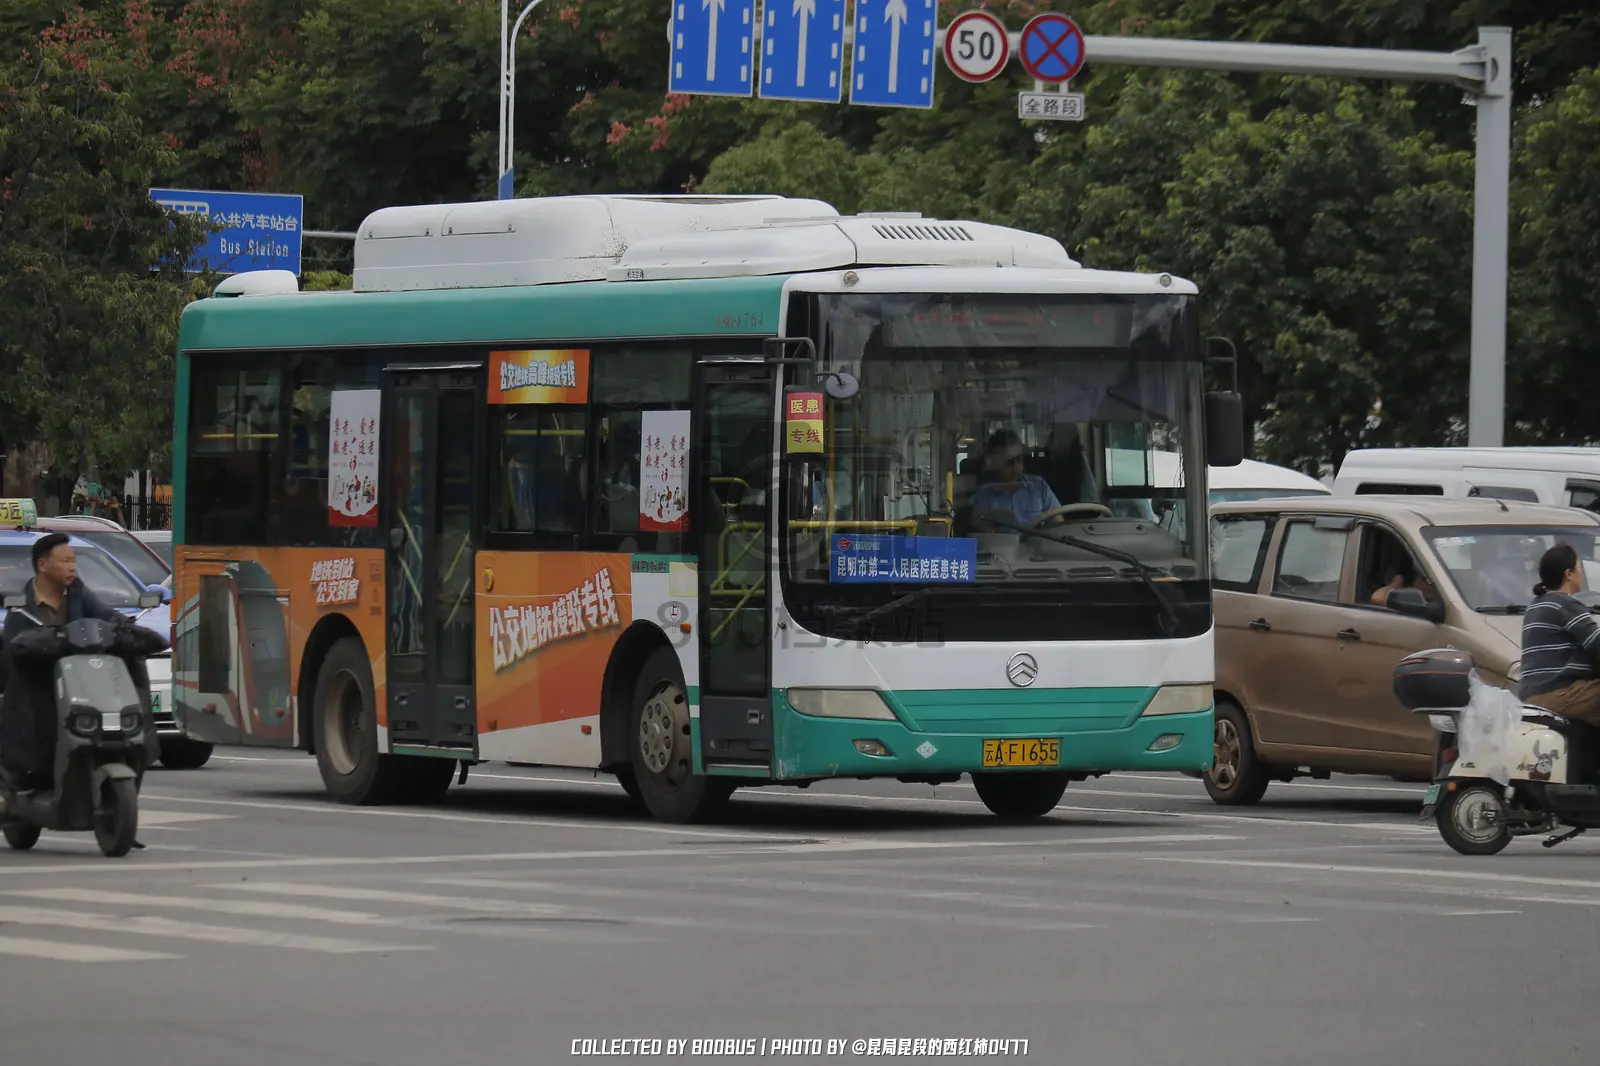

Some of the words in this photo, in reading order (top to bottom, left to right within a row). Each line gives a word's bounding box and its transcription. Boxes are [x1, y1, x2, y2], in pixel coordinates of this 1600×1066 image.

[958, 30, 995, 60] 50
[1025, 98, 1078, 115] 全路段
[213, 211, 298, 231] 公共汽车站台
[220, 238, 241, 255] Bus
[247, 239, 289, 257] Station
[790, 399, 820, 414] 医患
[790, 428, 820, 444] 专线
[310, 558, 354, 582] 地铁到站
[837, 555, 969, 581] 昆明市第二人民医院医患专线
[316, 579, 360, 603] 公交到家
[489, 567, 620, 672] 公交地铁接驳专线
